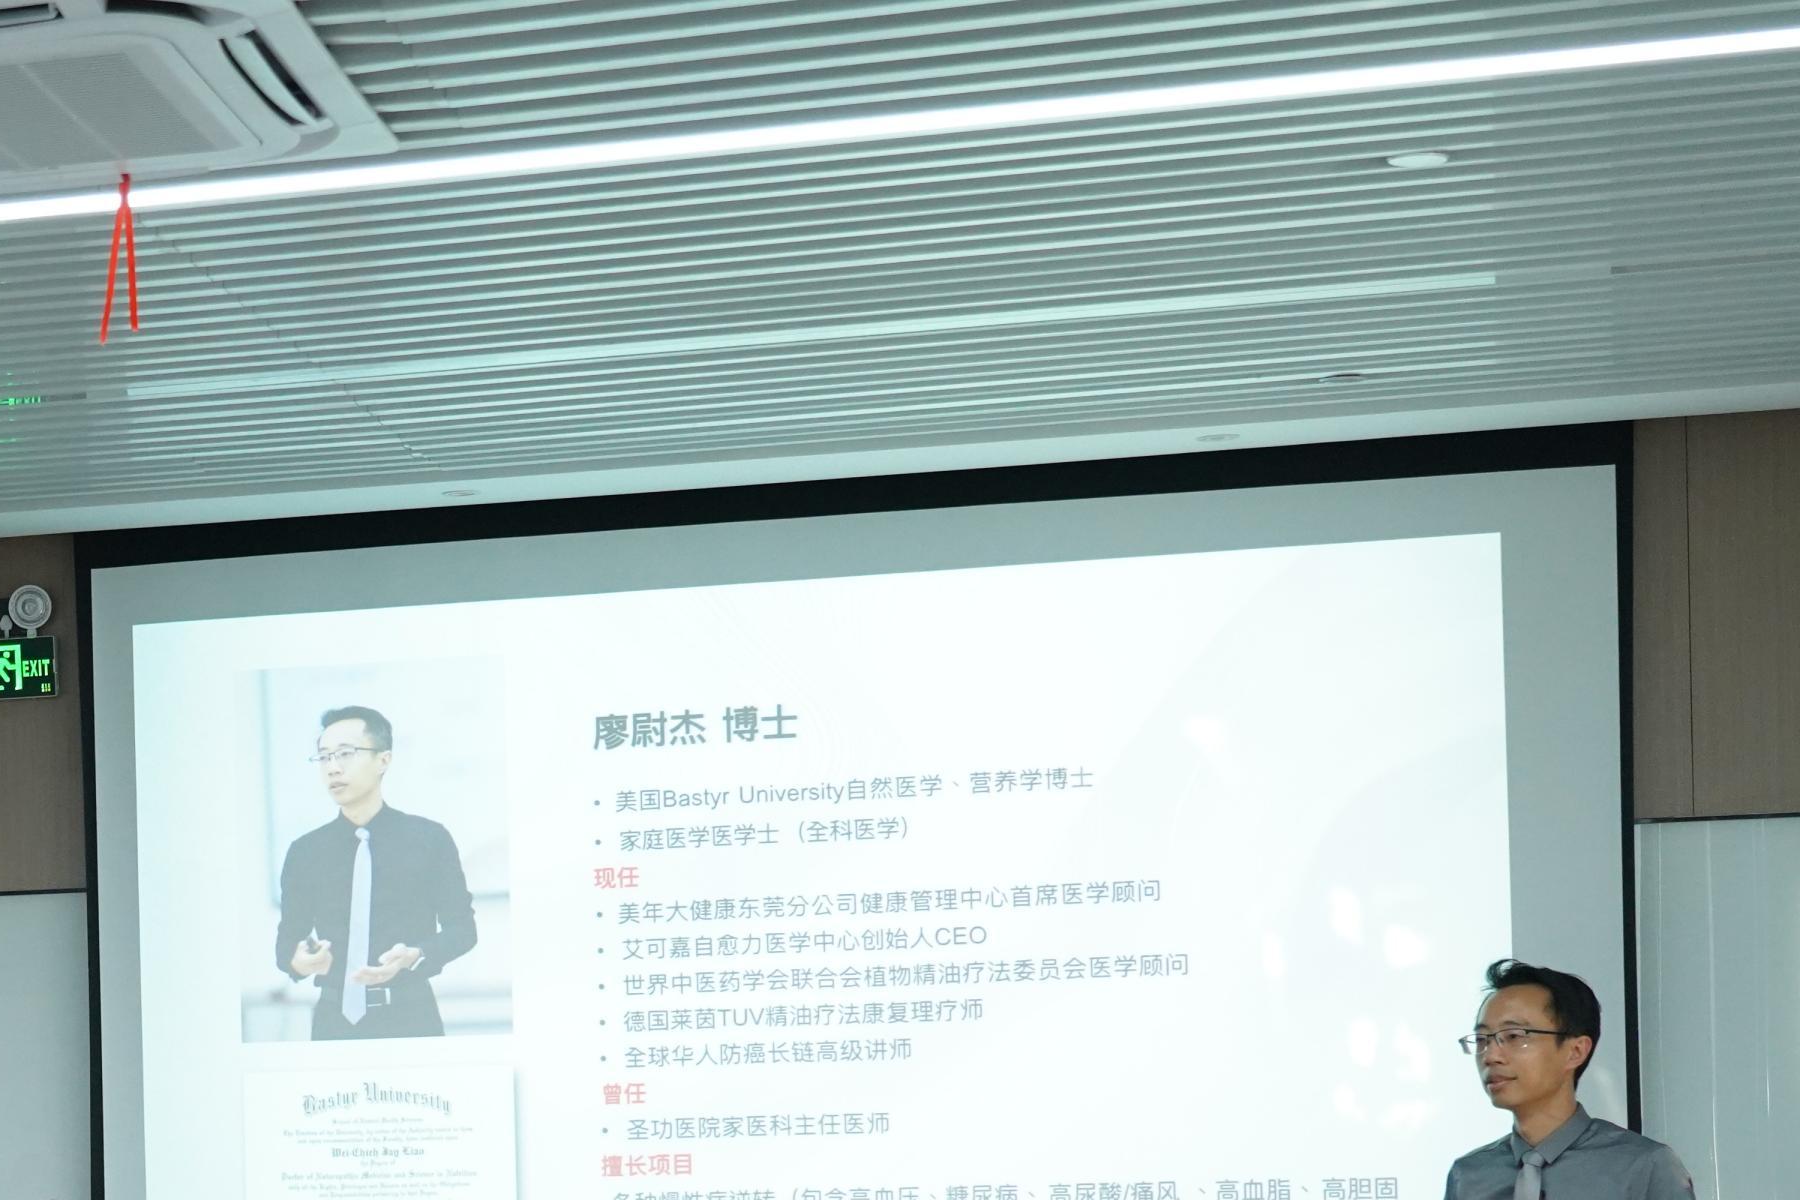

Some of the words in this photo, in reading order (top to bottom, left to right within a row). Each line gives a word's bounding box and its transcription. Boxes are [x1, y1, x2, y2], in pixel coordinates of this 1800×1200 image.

[23, 659, 50, 677] EXIT
[594, 709, 706, 750] 廖尉杰
[722, 704, 798, 743] 博士
[593, 867, 639, 889] 现任
[618, 879, 1160, 924] 美年大健康东莞分公司健康管理中心首席医学顾问
[622, 926, 987, 960] 艾可嘉自愈力医学中心创始人CEO
[623, 953, 1188, 996] 世界中医药学会联合会植物精油疗法委员会医学顾问
[624, 998, 983, 1032] 德国莱茵TUV精油疗法康复理疗师
[624, 1037, 912, 1068] 全球华人防癌长链高级讲师
[602, 1083, 647, 1105] 曾任
[627, 1112, 890, 1141] 圣功医院家医科主任医师
[601, 1153, 693, 1177] 擅长项目
